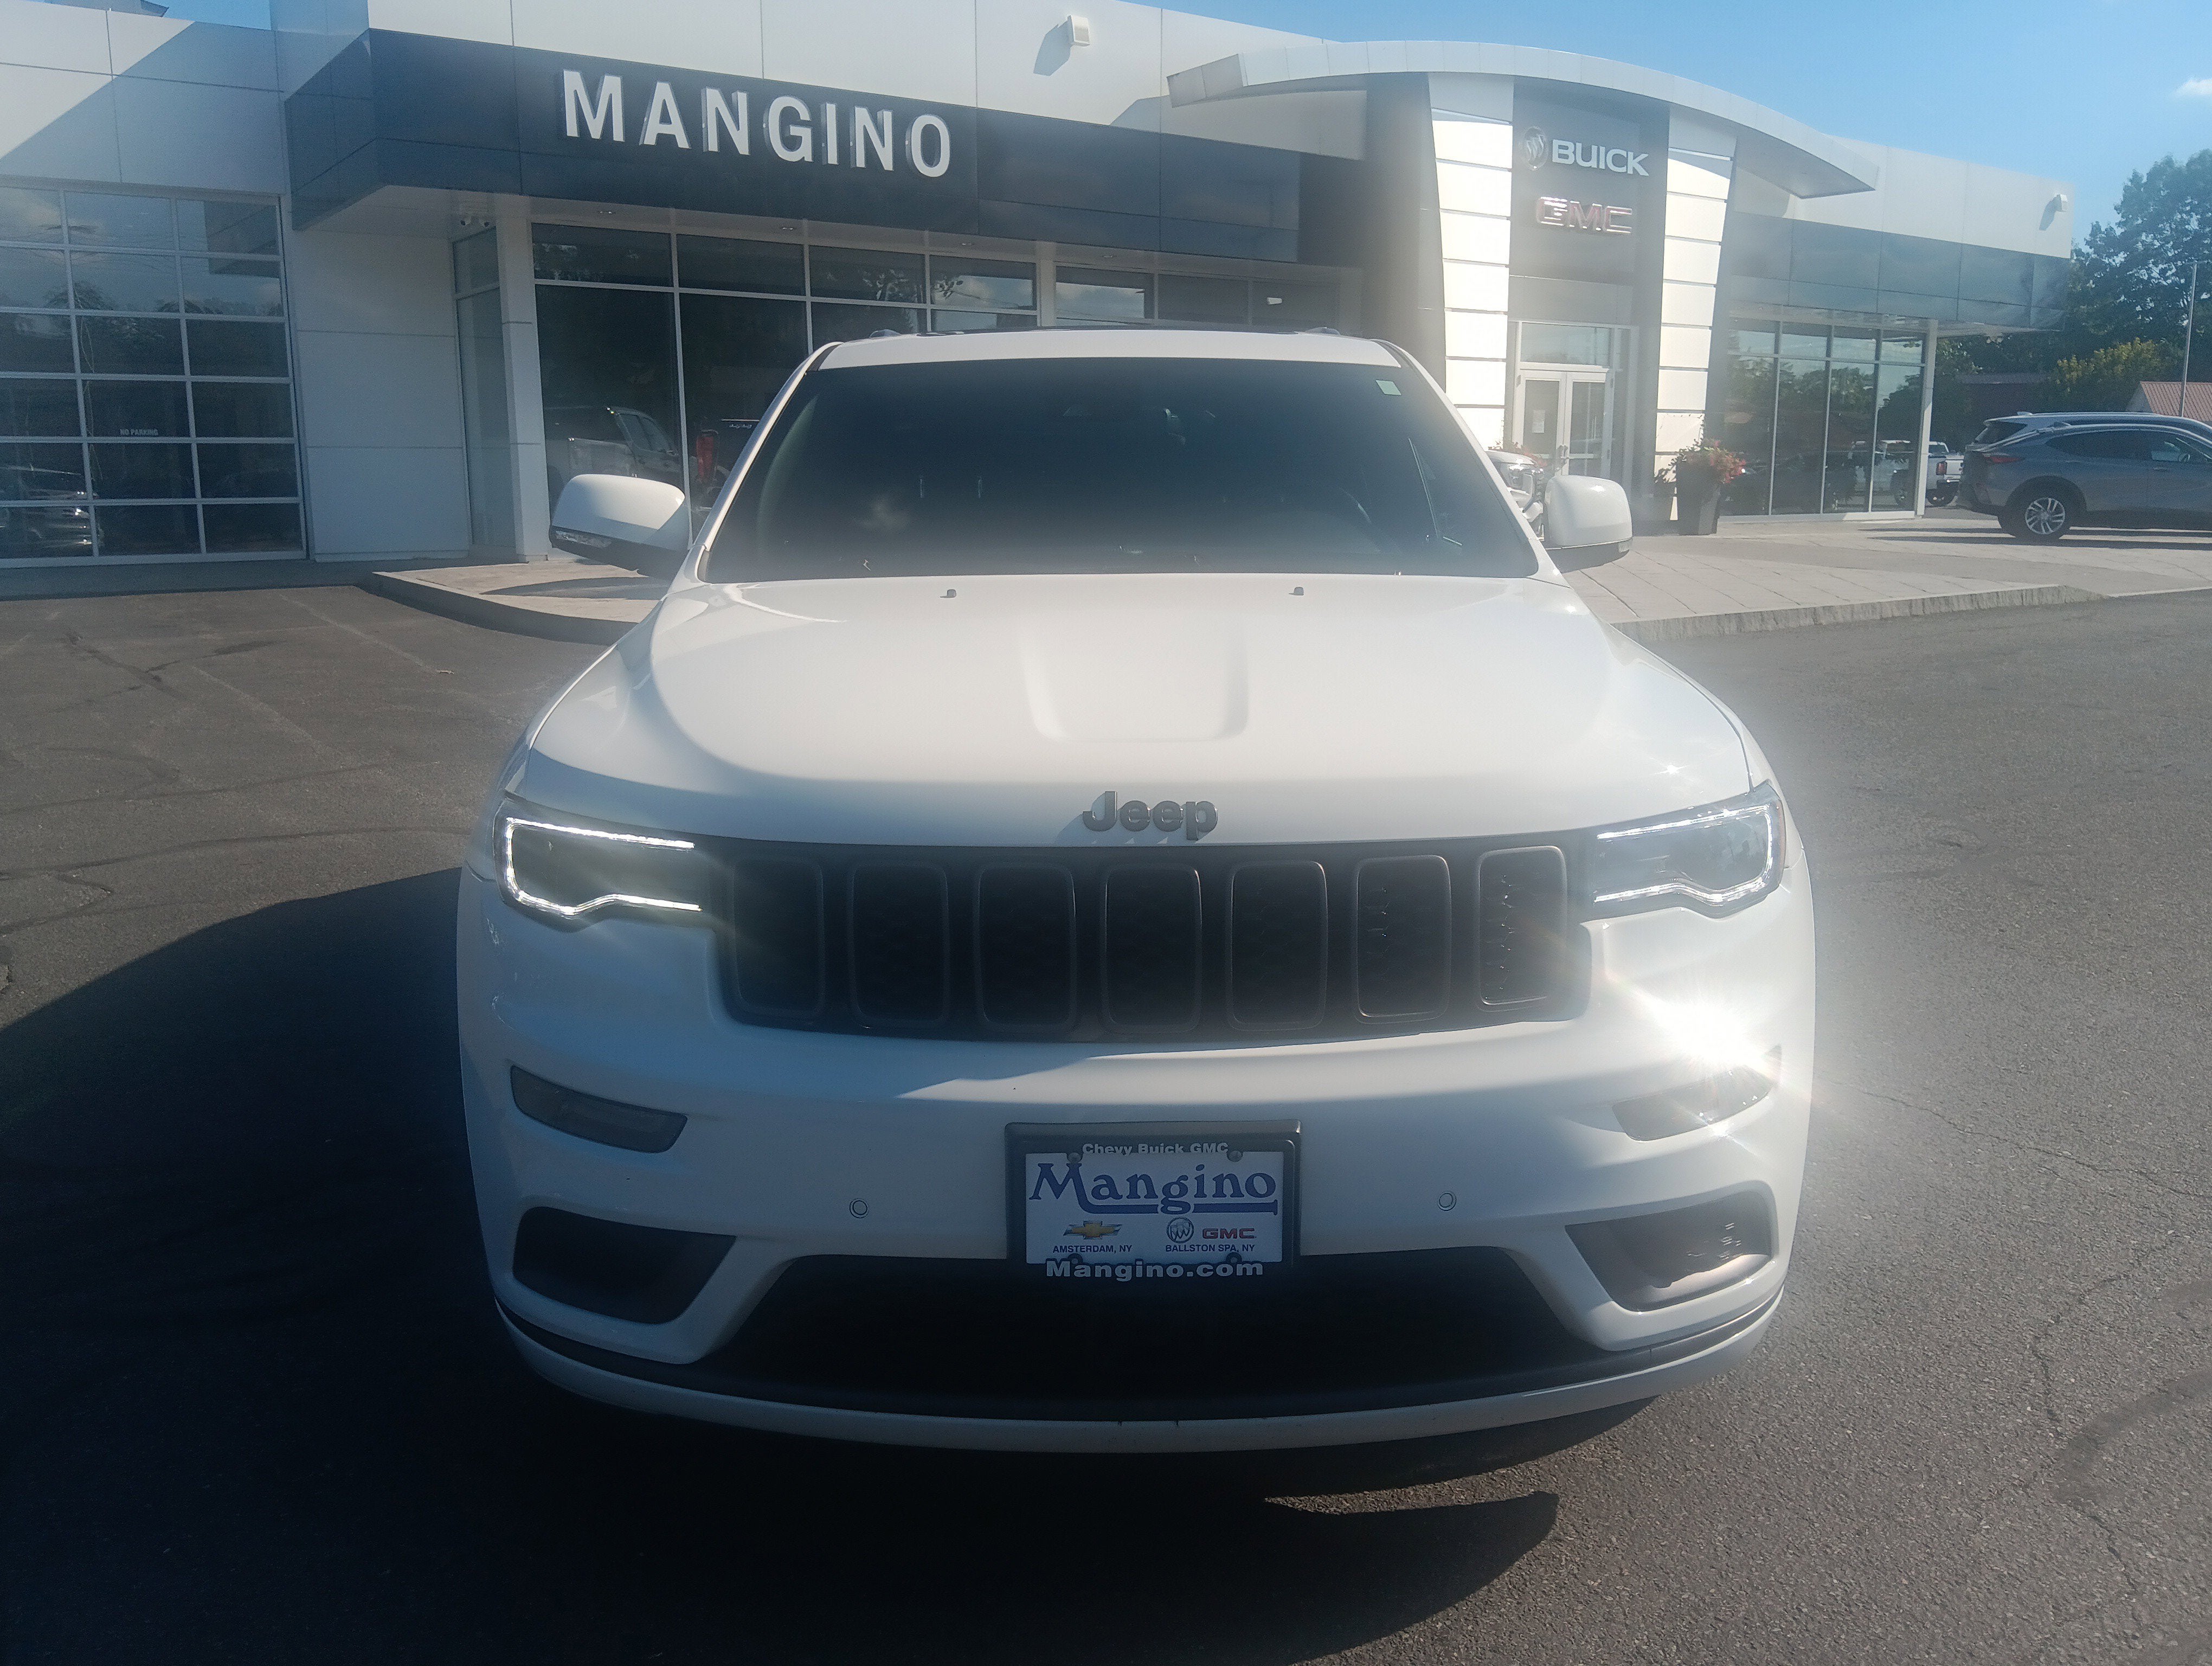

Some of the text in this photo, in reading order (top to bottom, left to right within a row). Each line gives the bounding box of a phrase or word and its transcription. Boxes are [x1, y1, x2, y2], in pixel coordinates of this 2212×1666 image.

[563, 68, 951, 177] MANGINO
[1552, 139, 1649, 176] BUICK
[1536, 196, 1633, 234] GMC
[1082, 791, 1218, 841] Jeep
[1083, 1142, 1229, 1156] Chevy Buick GMC
[1029, 1163, 1278, 1216] Mangino
[1202, 1228, 1255, 1239] GMC
[1053, 1245, 1116, 1253] AMSTERDAM,
[1166, 1244, 1216, 1252] BALLSTON
[1218, 1244, 1239, 1253] SPA,
[1046, 1260, 1263, 1282] Mangino.com
